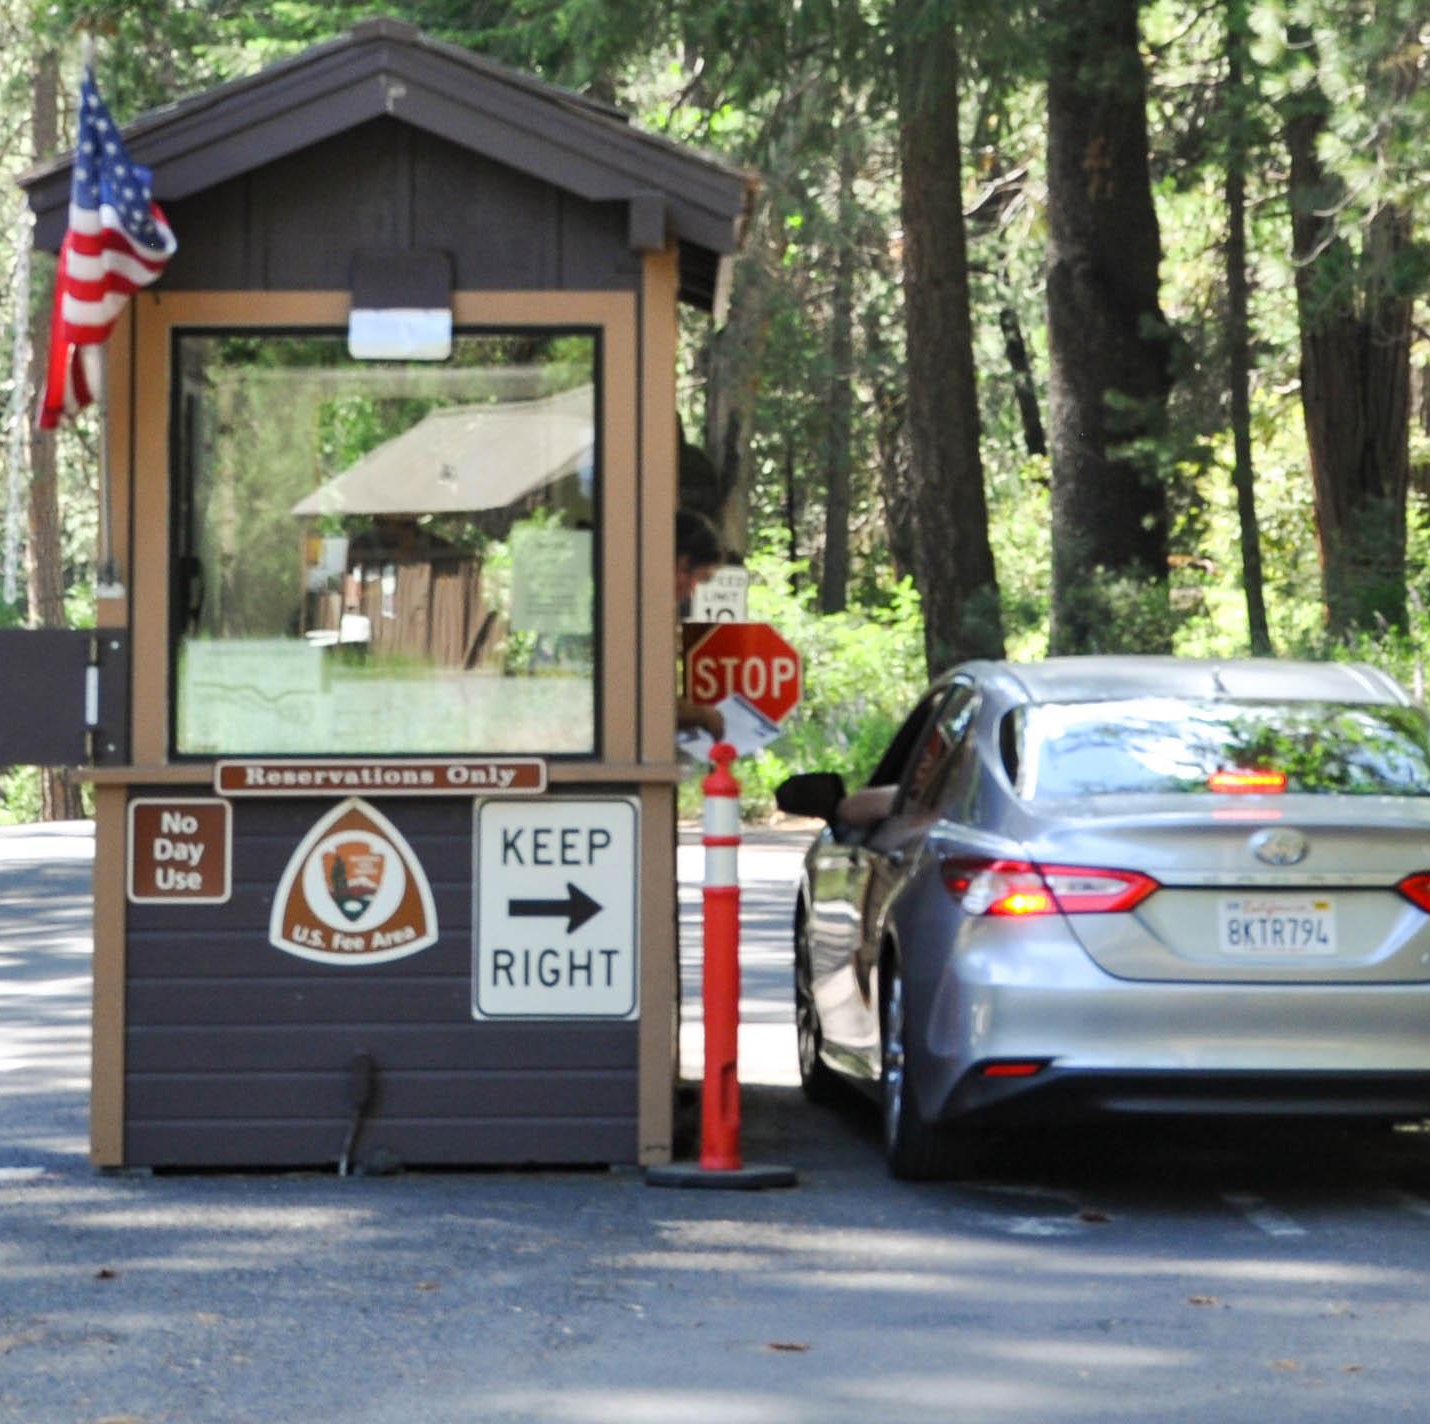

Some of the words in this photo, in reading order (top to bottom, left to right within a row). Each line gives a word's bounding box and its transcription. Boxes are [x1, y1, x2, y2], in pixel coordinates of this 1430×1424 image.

[694, 656, 796, 700] STOP
[244, 766, 435, 786] Reservations
[446, 765, 517, 787] Only
[161, 810, 199, 834] No
[154, 837, 205, 867] Day
[502, 828, 611, 866] KEEP
[155, 867, 203, 891] Use
[292, 924, 326, 948] U.S.
[331, 932, 365, 951] Fee
[371, 925, 417, 950] Area
[1227, 918, 1328, 946] 8KTR794
[492, 949, 620, 987] RIGHT
